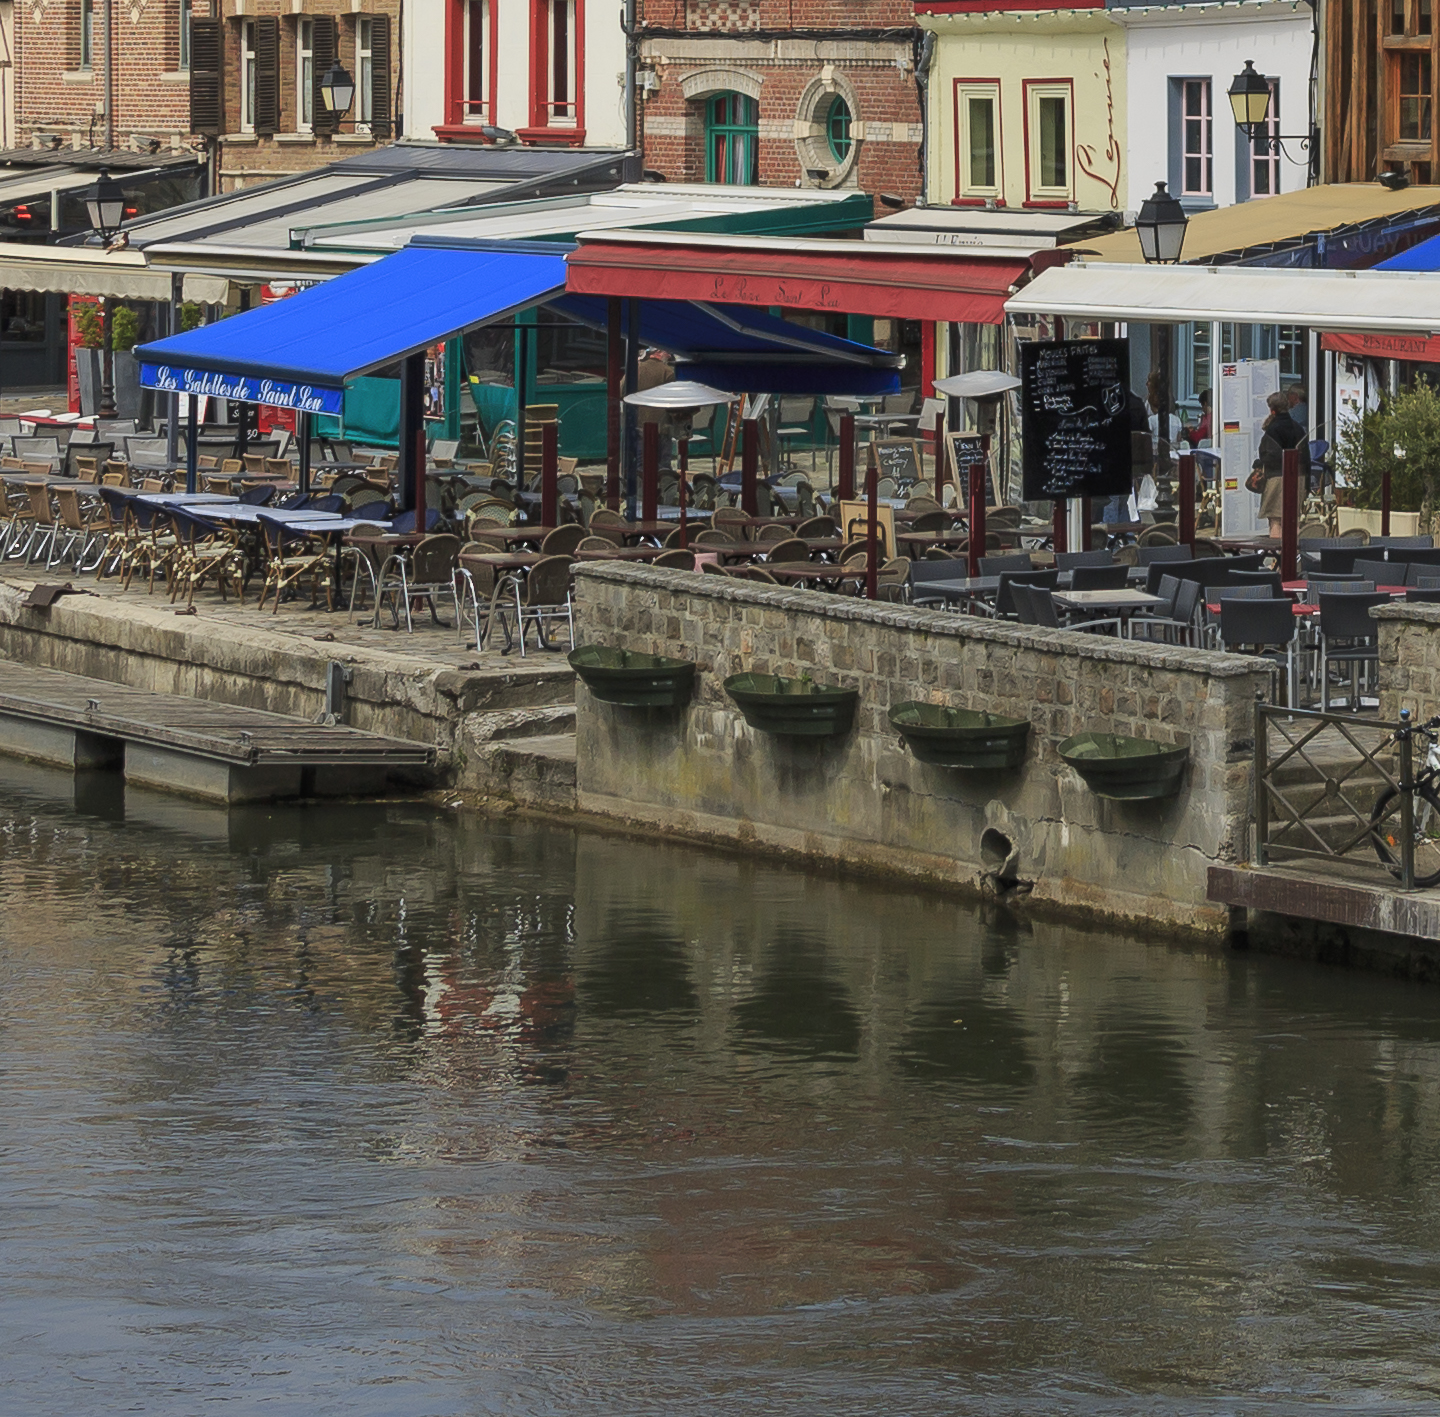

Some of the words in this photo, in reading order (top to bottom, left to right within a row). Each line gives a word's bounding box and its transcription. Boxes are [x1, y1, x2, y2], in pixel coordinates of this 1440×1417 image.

[1362, 336, 1428, 354] RESTAURANT
[155, 365, 179, 390] Les
[184, 368, 231, 397] Galettes
[232, 376, 250, 399] de
[258, 379, 297, 407] Saint
[297, 385, 323, 412] Leu
